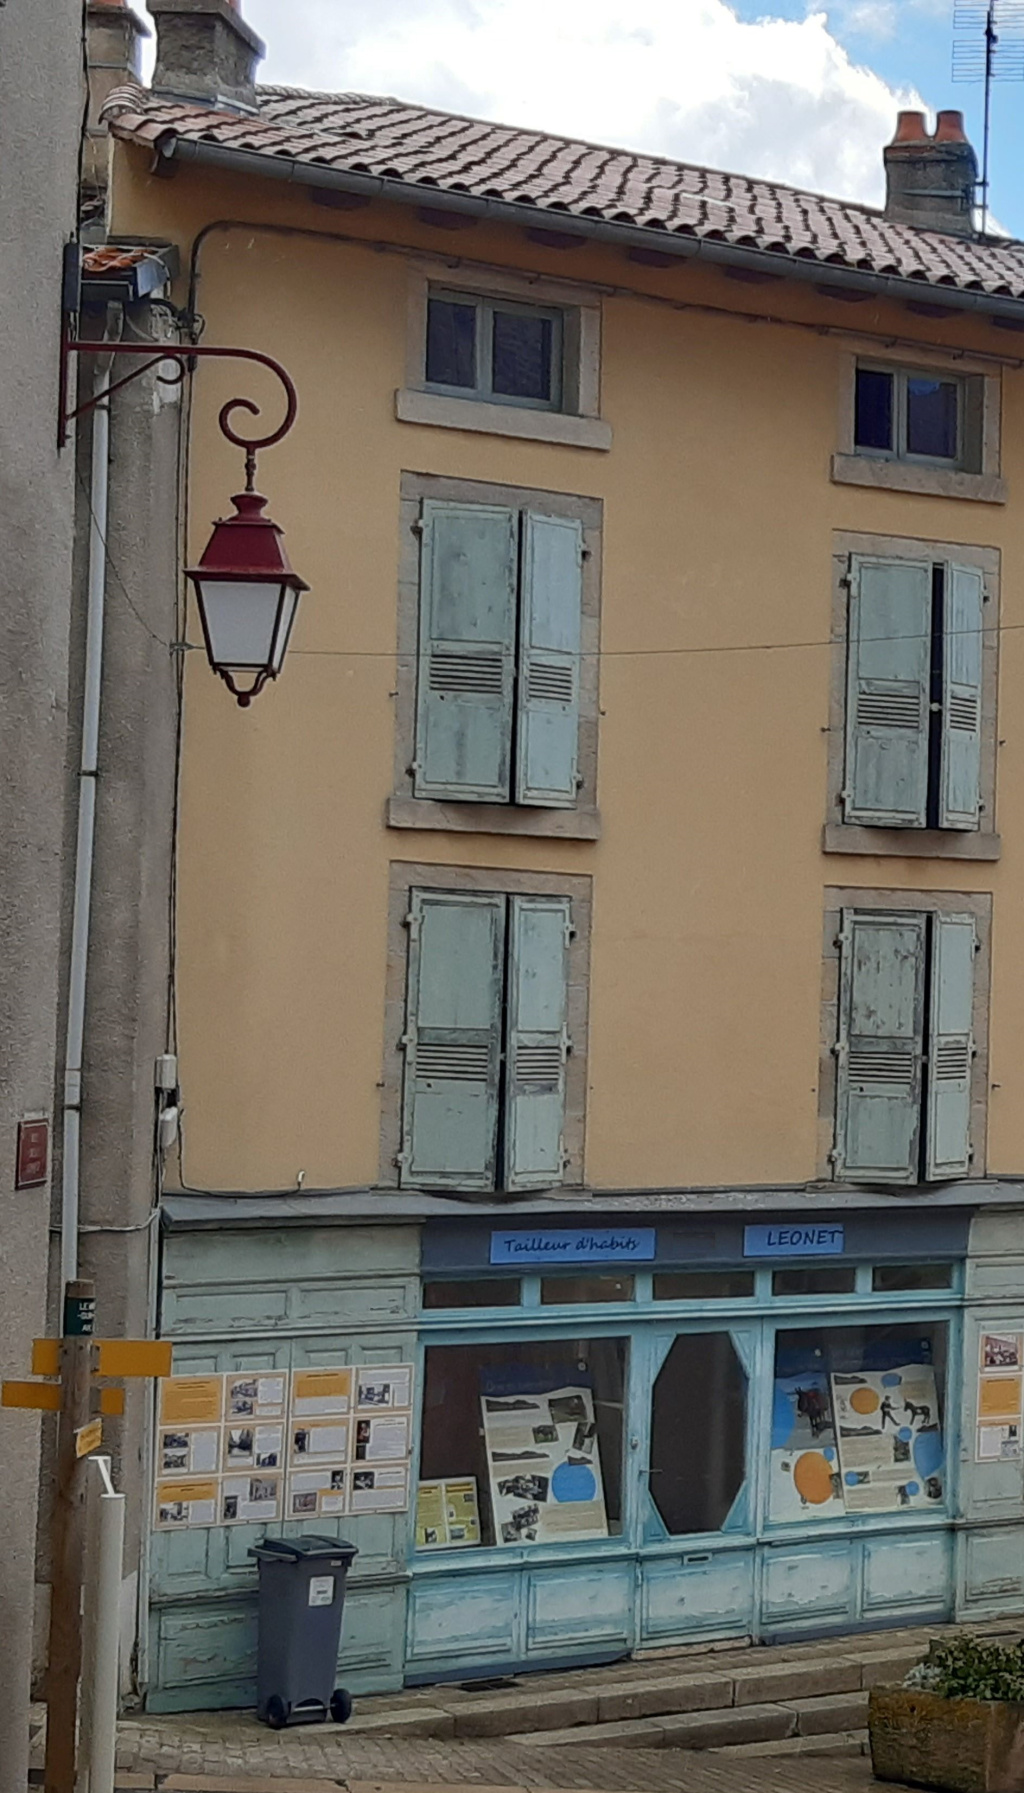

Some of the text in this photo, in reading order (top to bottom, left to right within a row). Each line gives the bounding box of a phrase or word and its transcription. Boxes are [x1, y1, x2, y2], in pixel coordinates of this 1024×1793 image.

[504, 1235, 640, 1253] Tailleur d'habits
[766, 1228, 844, 1246] LEONET
